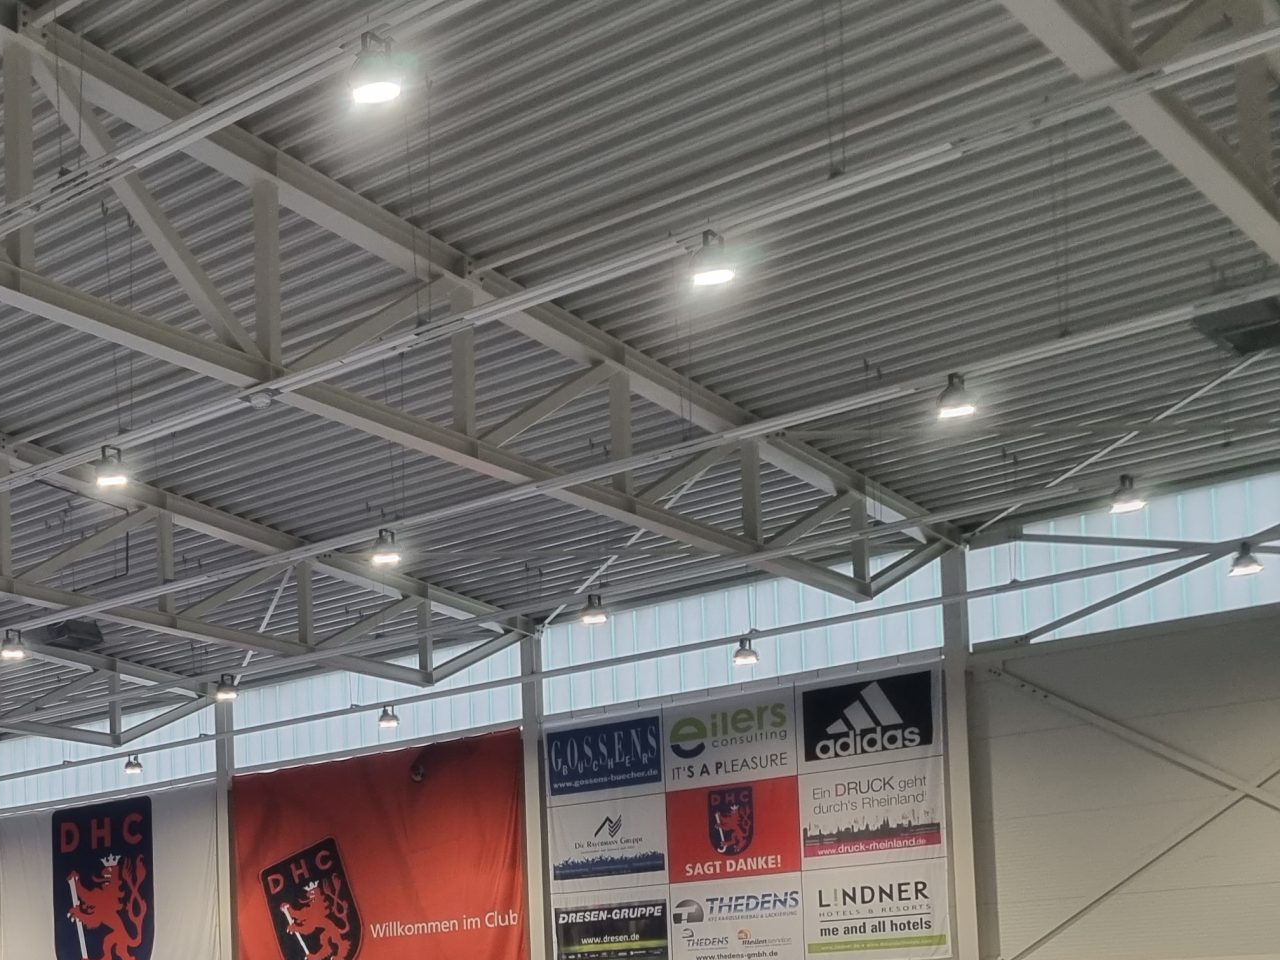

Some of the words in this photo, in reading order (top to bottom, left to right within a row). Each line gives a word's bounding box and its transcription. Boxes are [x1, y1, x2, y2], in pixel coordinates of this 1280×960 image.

[670, 703, 786, 758] eilers
[712, 729, 787, 748] consulting
[551, 726, 657, 772] GOSSENS
[815, 726, 921, 759] adidas
[672, 765, 695, 780] IT'S
[700, 763, 710, 776] A
[715, 752, 788, 775] PLEASURE
[553, 769, 658, 788] www.gossens-buecher.de
[812, 787, 831, 800] Ein
[835, 776, 895, 797] DRUCK
[898, 775, 927, 792] geht
[813, 800, 858, 815] durch's
[60, 813, 143, 853] DHC
[818, 838, 926, 855] www.druck-rheinland.de
[268, 850, 333, 895] DHC
[685, 861, 722, 876] SAGT
[726, 855, 782, 873] DANKE!
[705, 891, 800, 915] THEDENS
[819, 909, 860, 918] HOTELS
[881, 904, 932, 913] RESORTS
[370, 916, 459, 938] Willkommen
[463, 914, 481, 929] im
[485, 910, 519, 928] Club
[558, 906, 663, 924] DRESEN-GRUPPE
[820, 926, 839, 937] me
[843, 922, 866, 935] and
[871, 920, 886, 933] all
[890, 917, 932, 932] hotels
[581, 933, 640, 944] www.dresen.de
[687, 937, 729, 948] THEDENS
[696, 950, 778, 960] www.thedens-gmbh.de
